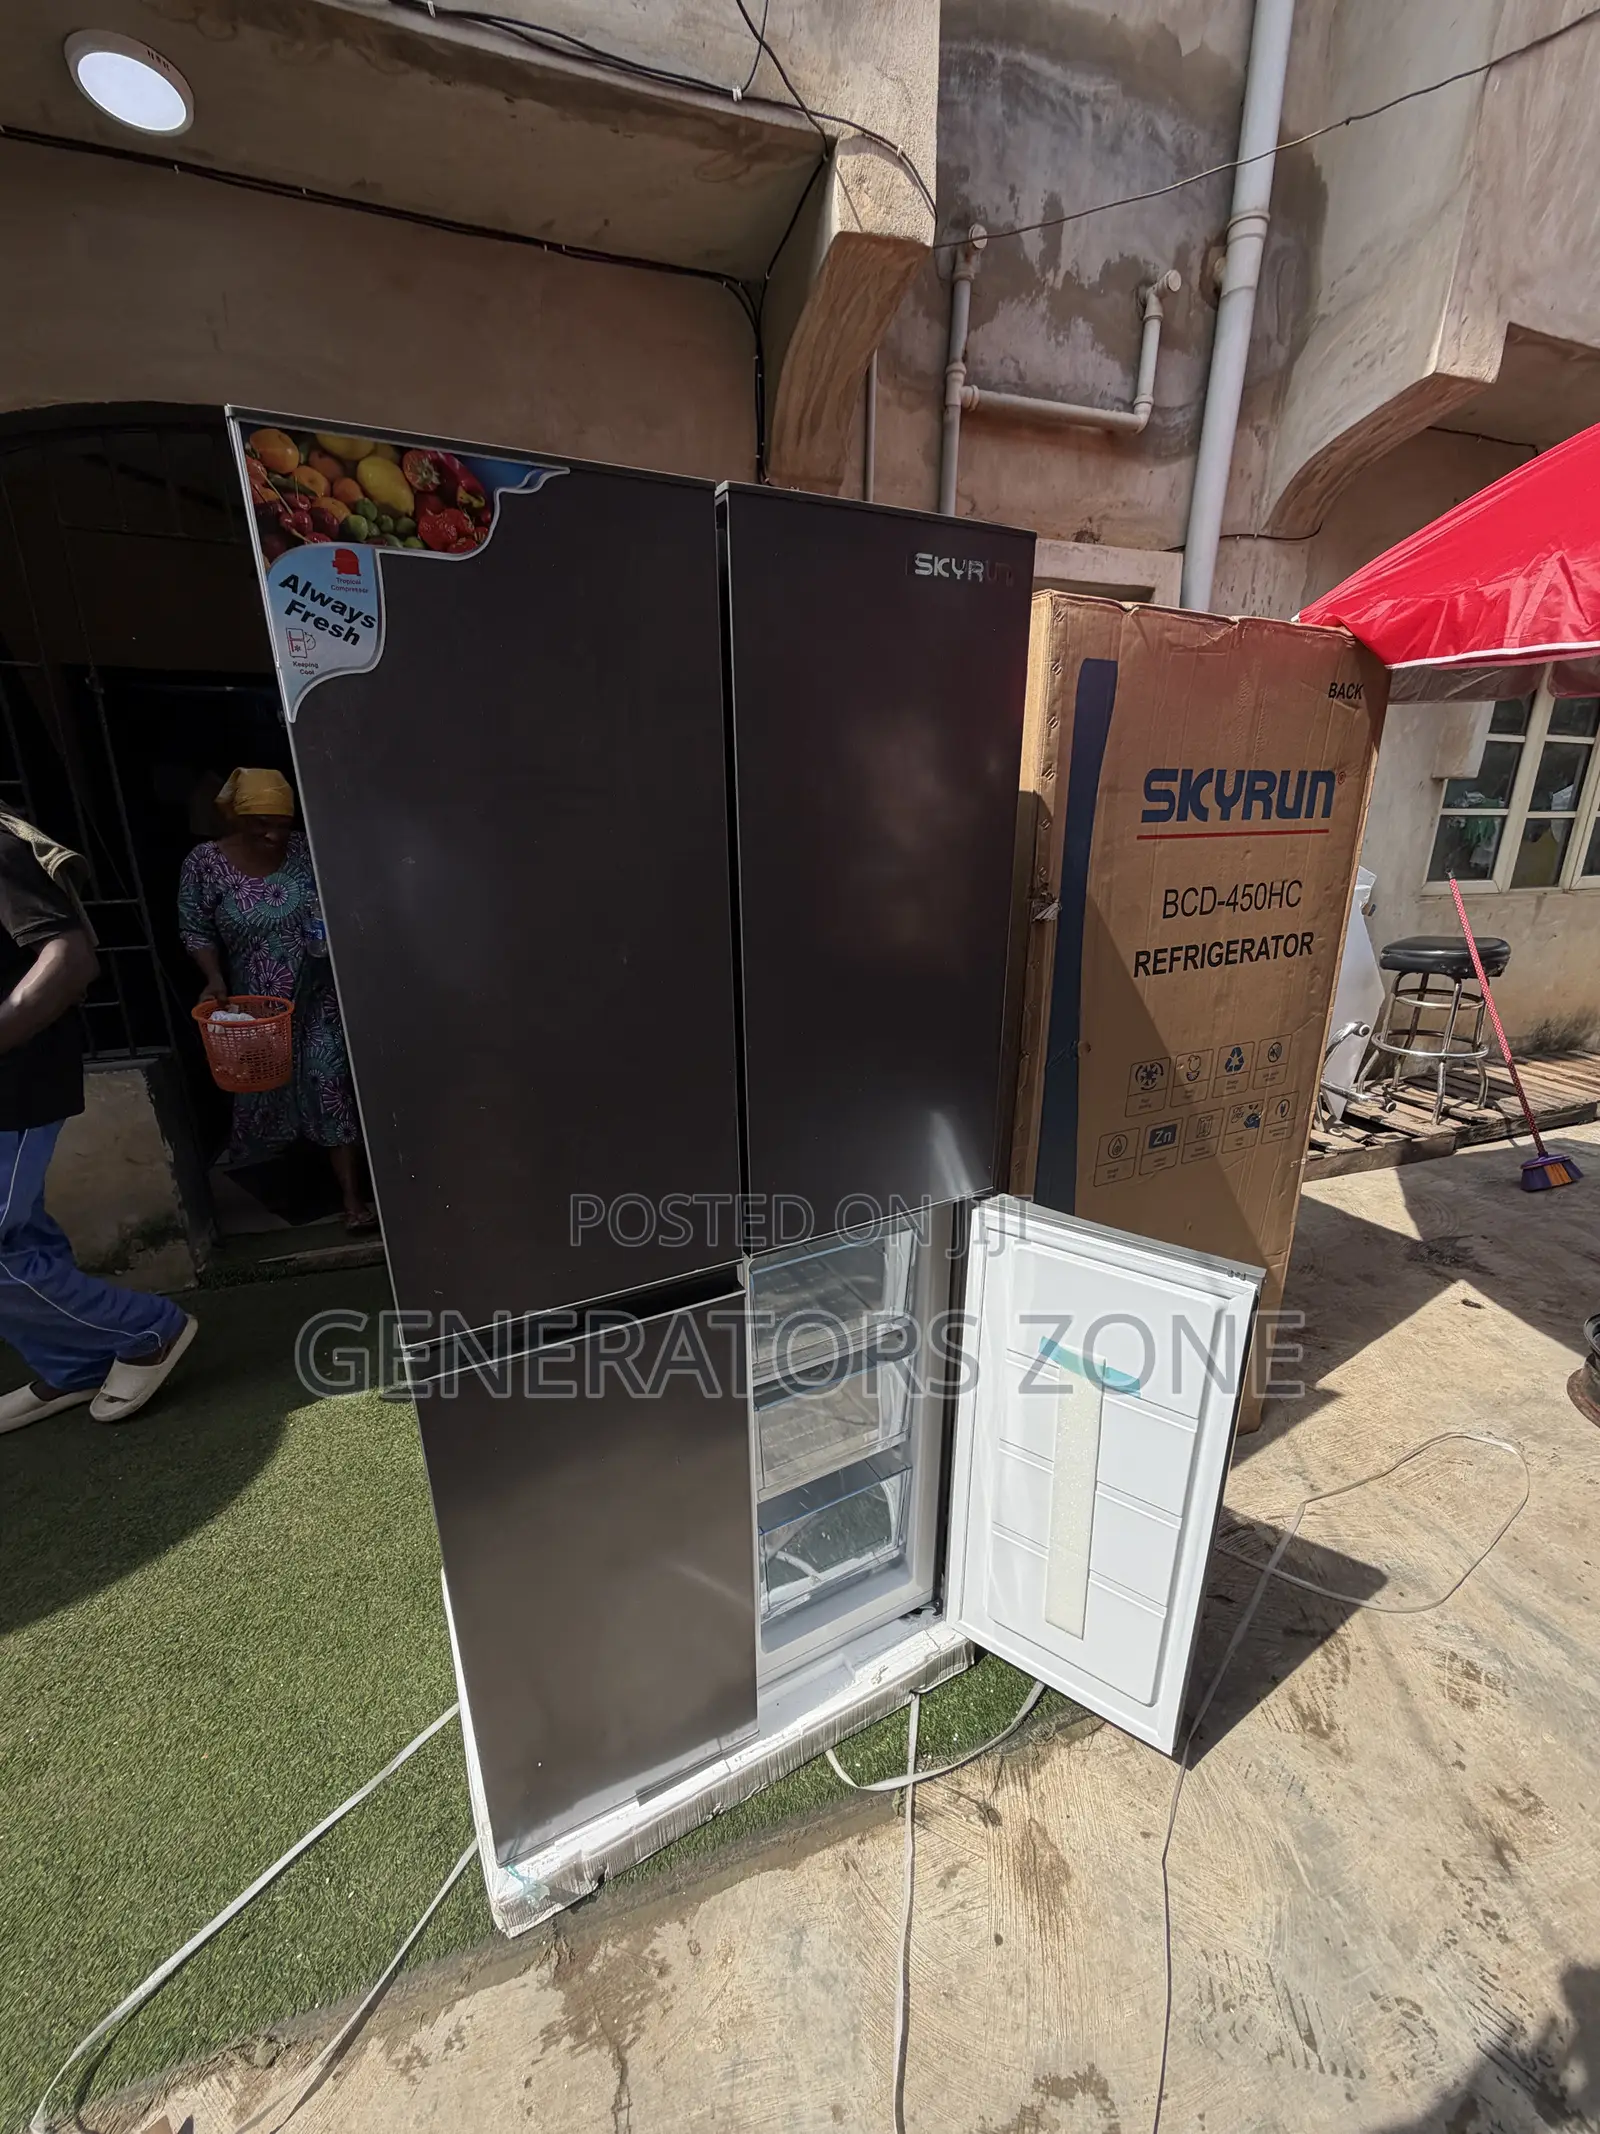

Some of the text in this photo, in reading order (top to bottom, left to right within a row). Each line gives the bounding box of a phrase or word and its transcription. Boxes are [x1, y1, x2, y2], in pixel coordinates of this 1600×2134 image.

[336, 577, 361, 585] Tropical
[279, 574, 377, 629] Always
[284, 598, 361, 646] Fresh
[292, 660, 319, 669] Keeping
[1327, 681, 1364, 700] BACK
[1140, 767, 1336, 824] SKYRUN
[1162, 880, 1303, 919] BCD-450HC
[1133, 932, 1315, 977] REFRIGERATOR
[1153, 1129, 1172, 1146] Zn
